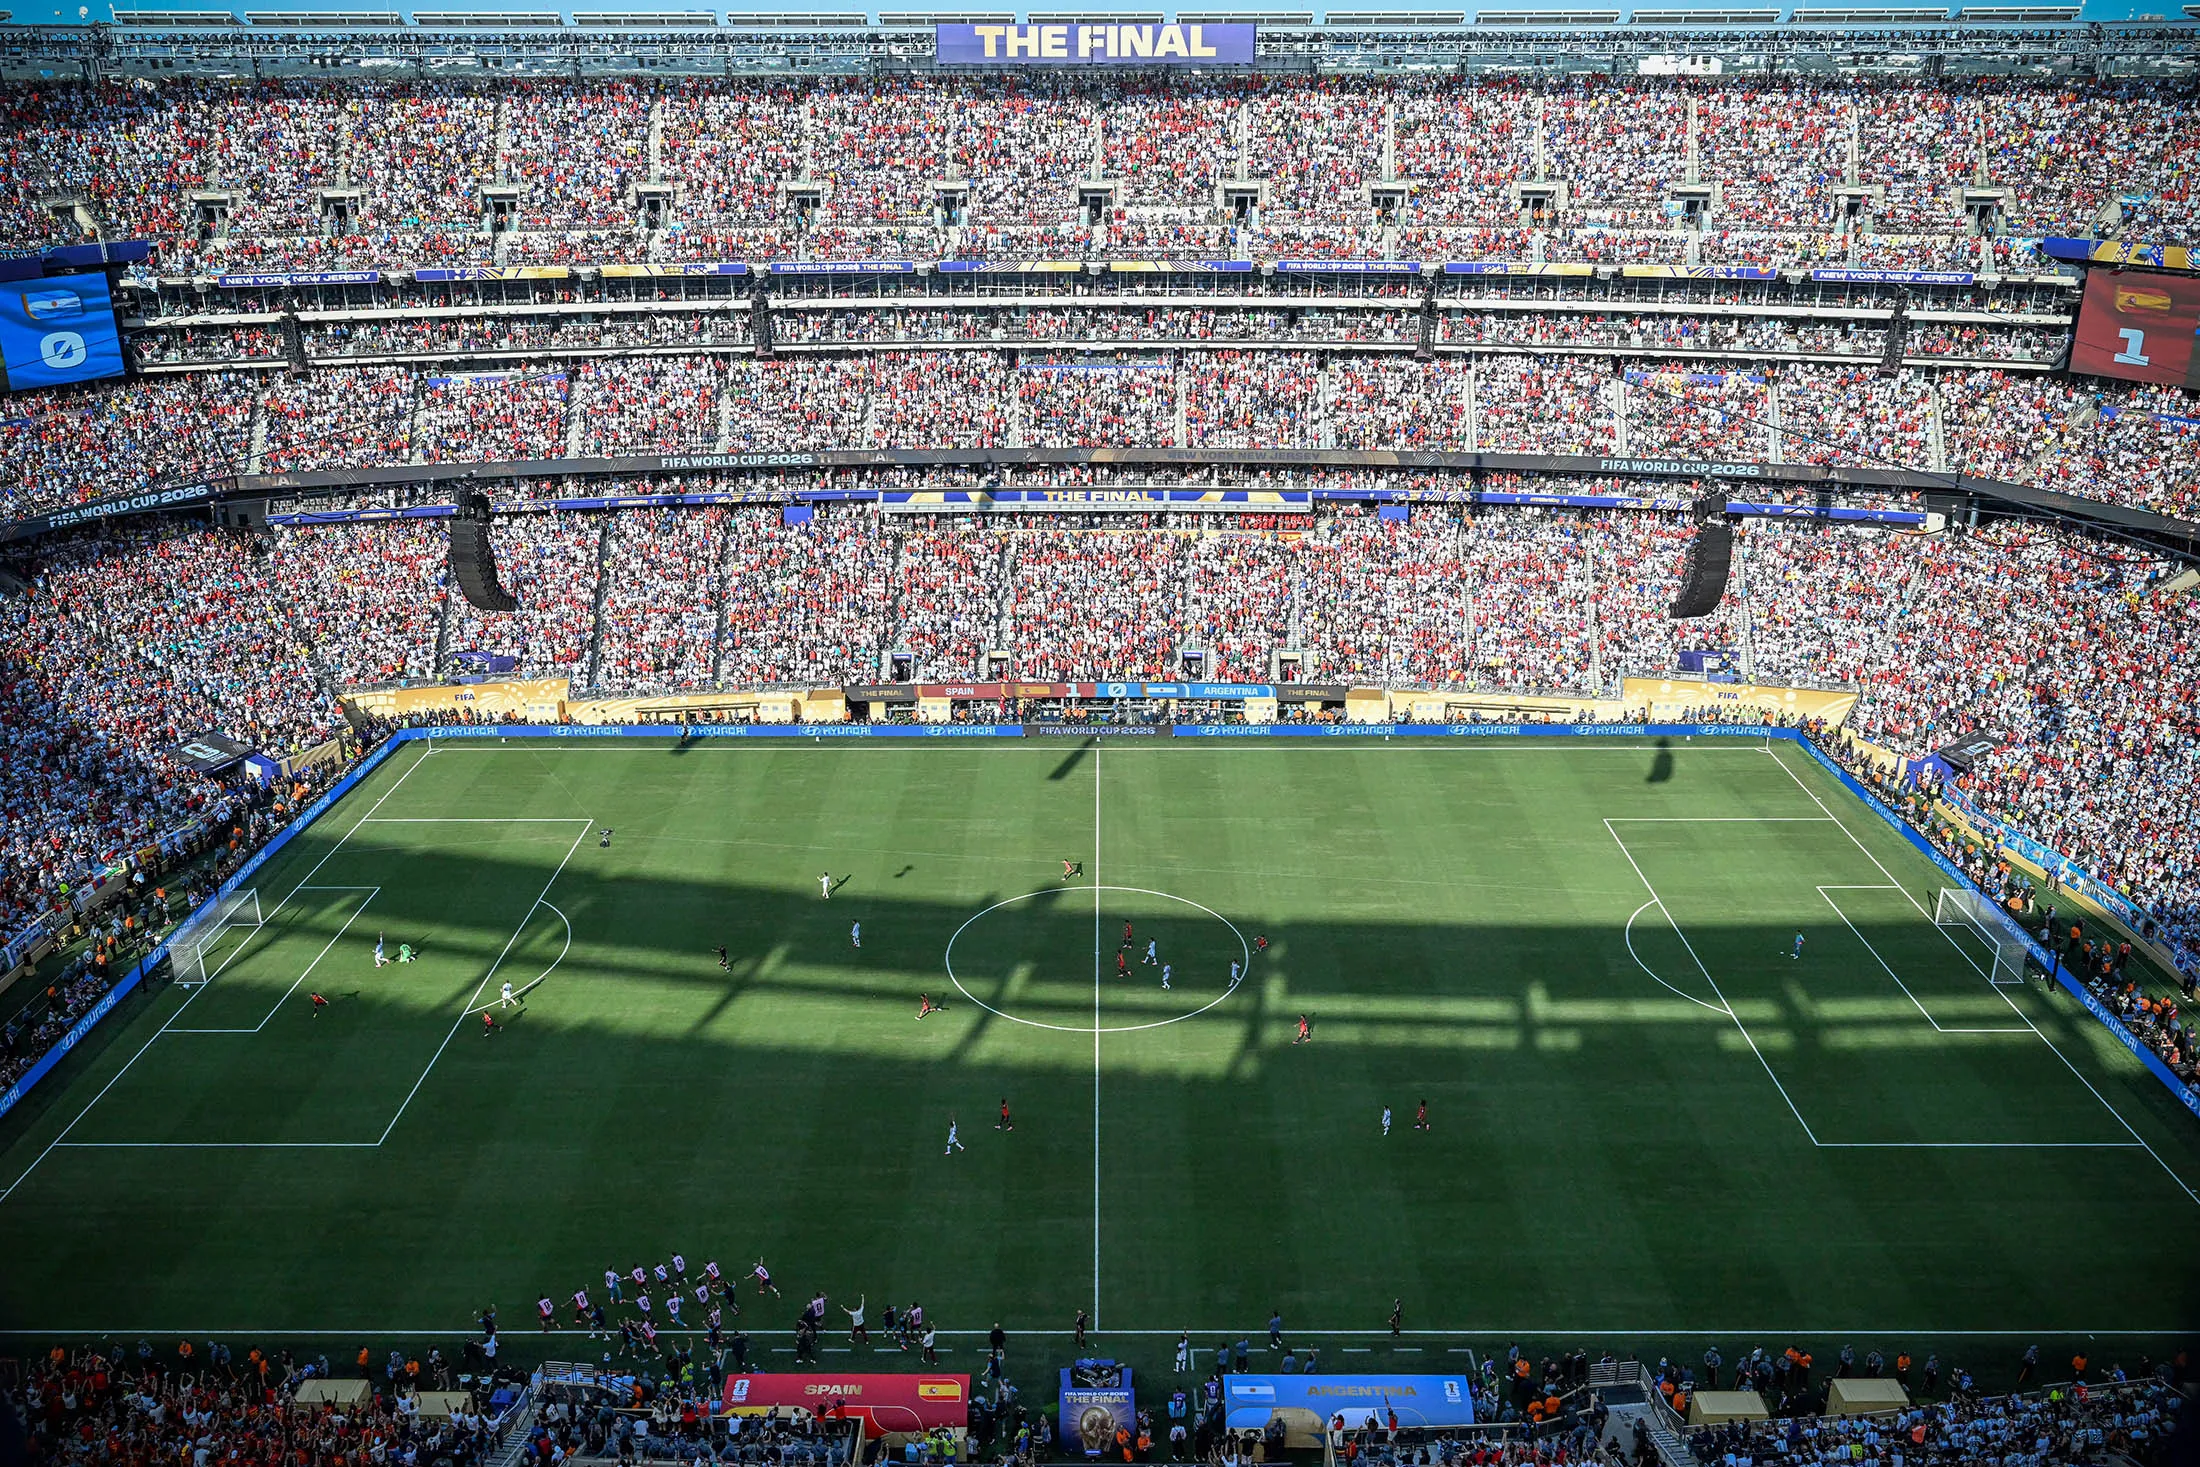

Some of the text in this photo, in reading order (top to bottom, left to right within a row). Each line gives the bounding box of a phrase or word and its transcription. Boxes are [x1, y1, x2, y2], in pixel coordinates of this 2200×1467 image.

[975, 25, 1216, 57] THE FINAL
[226, 274, 370, 284] NEW YORK NEW JERSEY
[1851, 272, 1883, 280] YORK
[1886, 273, 1912, 281] NEW
[1916, 274, 1966, 282] JERSEY
[40, 331, 87, 369] 0
[2114, 328, 2150, 366] 1
[661, 458, 689, 468] FIFA
[691, 456, 736, 467] WORLD
[740, 456, 766, 466] CUP
[768, 454, 812, 464] 2026
[1168, 451, 1320, 460] NEW YORK NEW JERSEY
[1601, 460, 1629, 470] FIFA
[1632, 462, 1680, 472] WORLD
[1682, 463, 1710, 474] CUP
[1712, 464, 1760, 476] 2026
[1044, 491, 1154, 502] THE FINAL
[49, 511, 79, 528] FIFA
[80, 500, 129, 520] WORLD
[131, 494, 159, 512] CUP
[161, 484, 208, 503] 2026
[945, 687, 974, 696] SPAIN
[1066, 684, 1080, 697] 1
[1108, 684, 1127, 696] 0
[1204, 687, 1259, 696] ARGENTINA
[1718, 692, 1738, 700] FIFA
[450, 727, 498, 735] HYUNDAI
[574, 727, 623, 735] HYUNDAI
[700, 726, 748, 734] HYUNDAI
[823, 726, 872, 734] HYUNDAI
[948, 726, 996, 735] HYUNDAI
[1040, 726, 1156, 735] FIFA WORLD CUP 2026
[1347, 727, 1396, 735] HYUNDAI
[1472, 726, 1520, 734] HYUNDAI
[1596, 727, 1644, 735] HYUNDAI
[1721, 727, 1772, 736] HYUNDAI
[363, 745, 389, 773] HYUNDAI
[1817, 752, 1842, 778] HYUNDAI
[305, 796, 331, 822] HYUNDAI
[1875, 803, 1903, 832] HYUNDAI
[237, 850, 266, 880] HYUNDAI
[1943, 861, 1974, 891] HYUNDAI
[77, 993, 116, 1034] HYUNDAI
[2098, 1008, 2138, 1052] HYUNDAI
[804, 1384, 862, 1395] SPAIN
[1307, 1386, 1417, 1396] ARGENTINA
